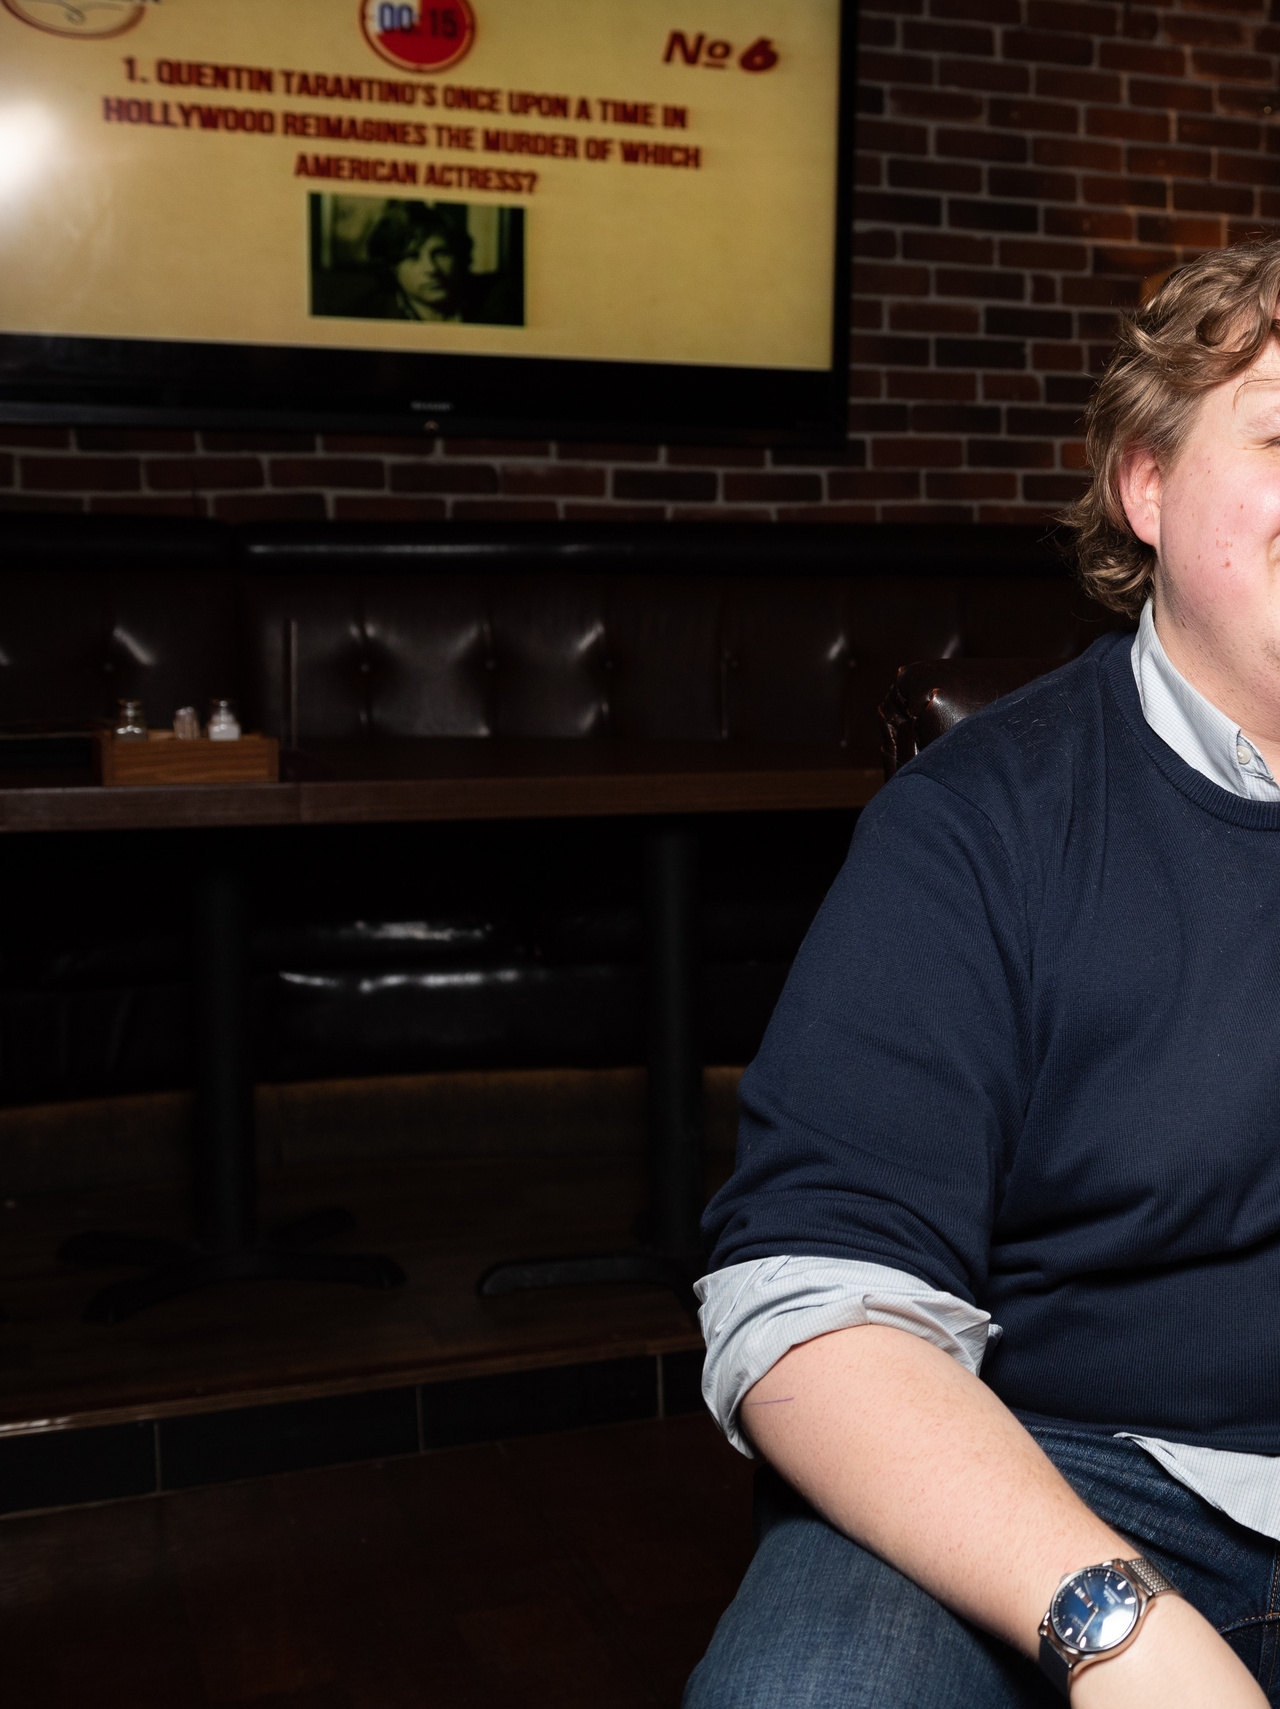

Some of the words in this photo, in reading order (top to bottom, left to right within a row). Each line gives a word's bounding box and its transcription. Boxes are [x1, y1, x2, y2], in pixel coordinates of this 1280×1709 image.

[739, 36, 779, 74] 6
[121, 55, 148, 83] 1.
[156, 57, 274, 93] QUENTIN
[280, 68, 437, 107] TARANTINO'S
[443, 85, 500, 113] ONCE
[508, 89, 570, 119] UPON
[575, 97, 591, 122] A
[598, 97, 655, 127] TIME
[662, 104, 688, 130] IN
[102, 95, 275, 135] HOLLYWOOD
[282, 110, 427, 146] REIMAGINES
[433, 124, 475, 151] THE
[482, 127, 578, 160] MURDER
[584, 136, 612, 161] OF
[619, 139, 701, 170] WHICH
[294, 151, 417, 186] AMERICAN
[424, 162, 538, 195] ACTRESS?
